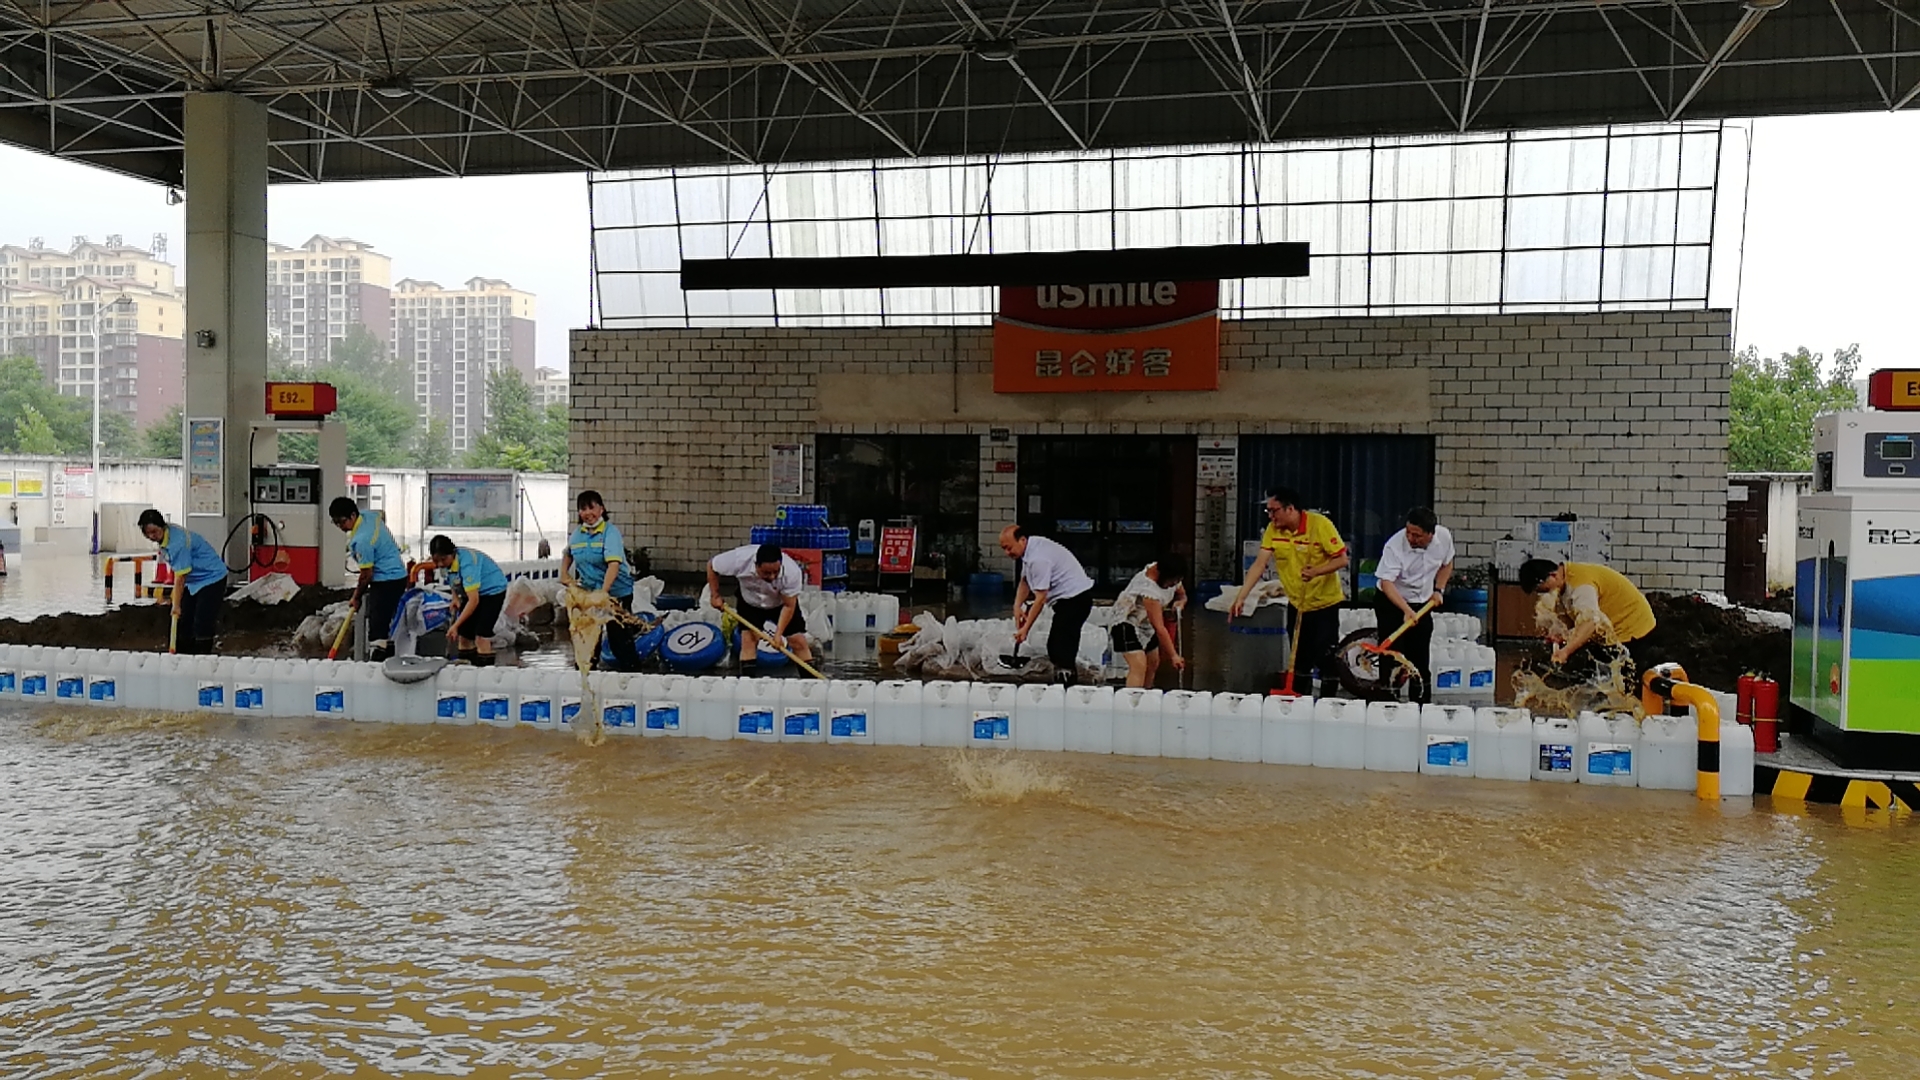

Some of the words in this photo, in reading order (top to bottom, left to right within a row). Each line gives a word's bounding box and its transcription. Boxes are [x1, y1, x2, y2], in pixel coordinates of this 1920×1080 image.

[1035, 348, 1172, 377] 昆仑好客
[279, 392, 299, 404] E92
